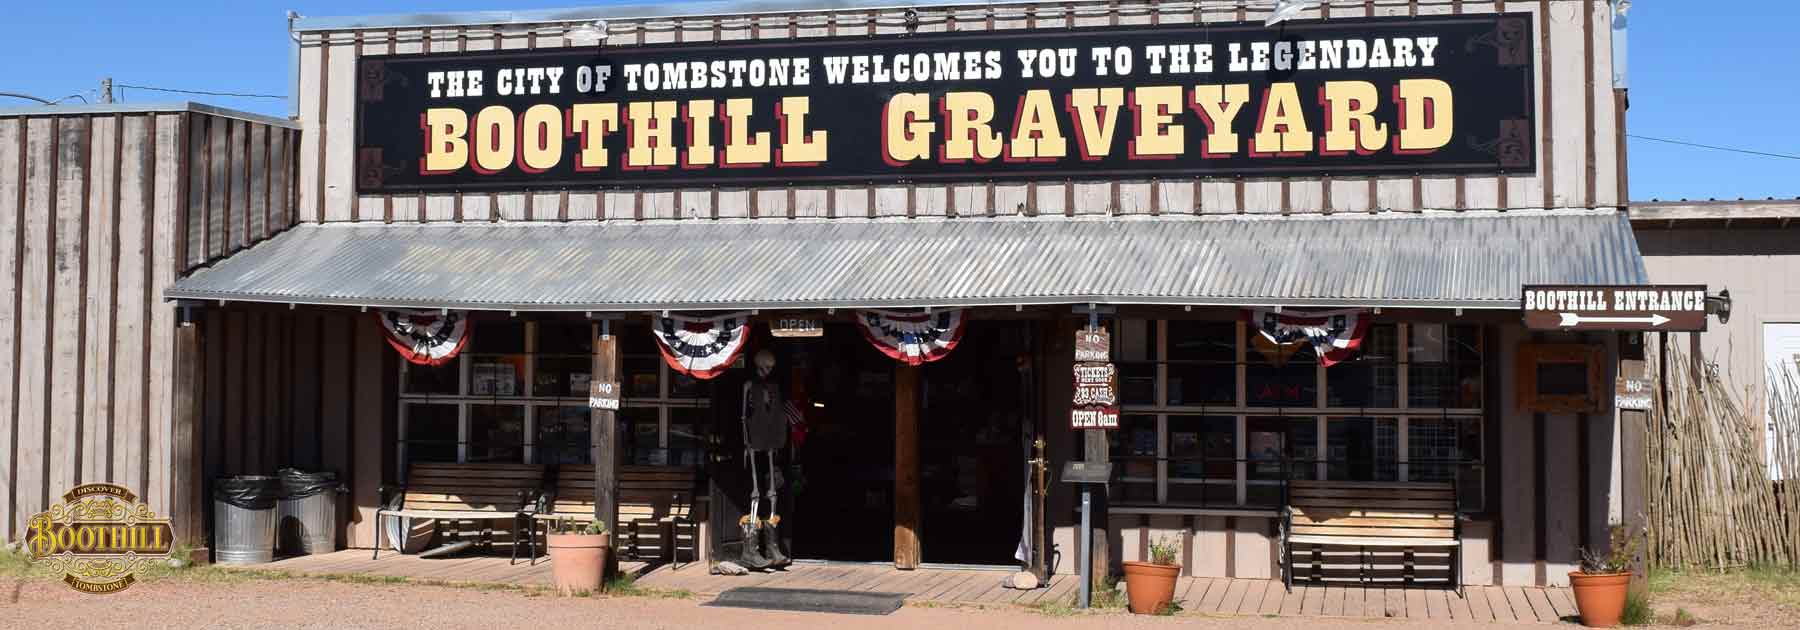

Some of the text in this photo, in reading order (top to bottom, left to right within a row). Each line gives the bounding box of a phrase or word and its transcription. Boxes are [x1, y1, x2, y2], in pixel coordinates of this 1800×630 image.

[428, 36, 1439, 98] THE CITY OF TOMBSTONE WELCOMES YOU TO THE LEGENDARY
[421, 78, 1454, 175] BOOTHILL GRAVEYARD
[1525, 290, 1706, 311] BOOTHILL ENTRANCE
[1086, 334, 1100, 343] NO
[1075, 350, 1109, 359] PARKING
[1080, 366, 1108, 378] TICKETS
[598, 383, 612, 394] NO
[1256, 384, 1300, 400] AM
[1626, 380, 1642, 392] NO
[589, 397, 619, 410] PARKING
[1615, 396, 1651, 409] PARKING
[1072, 410, 1096, 426] OPEN
